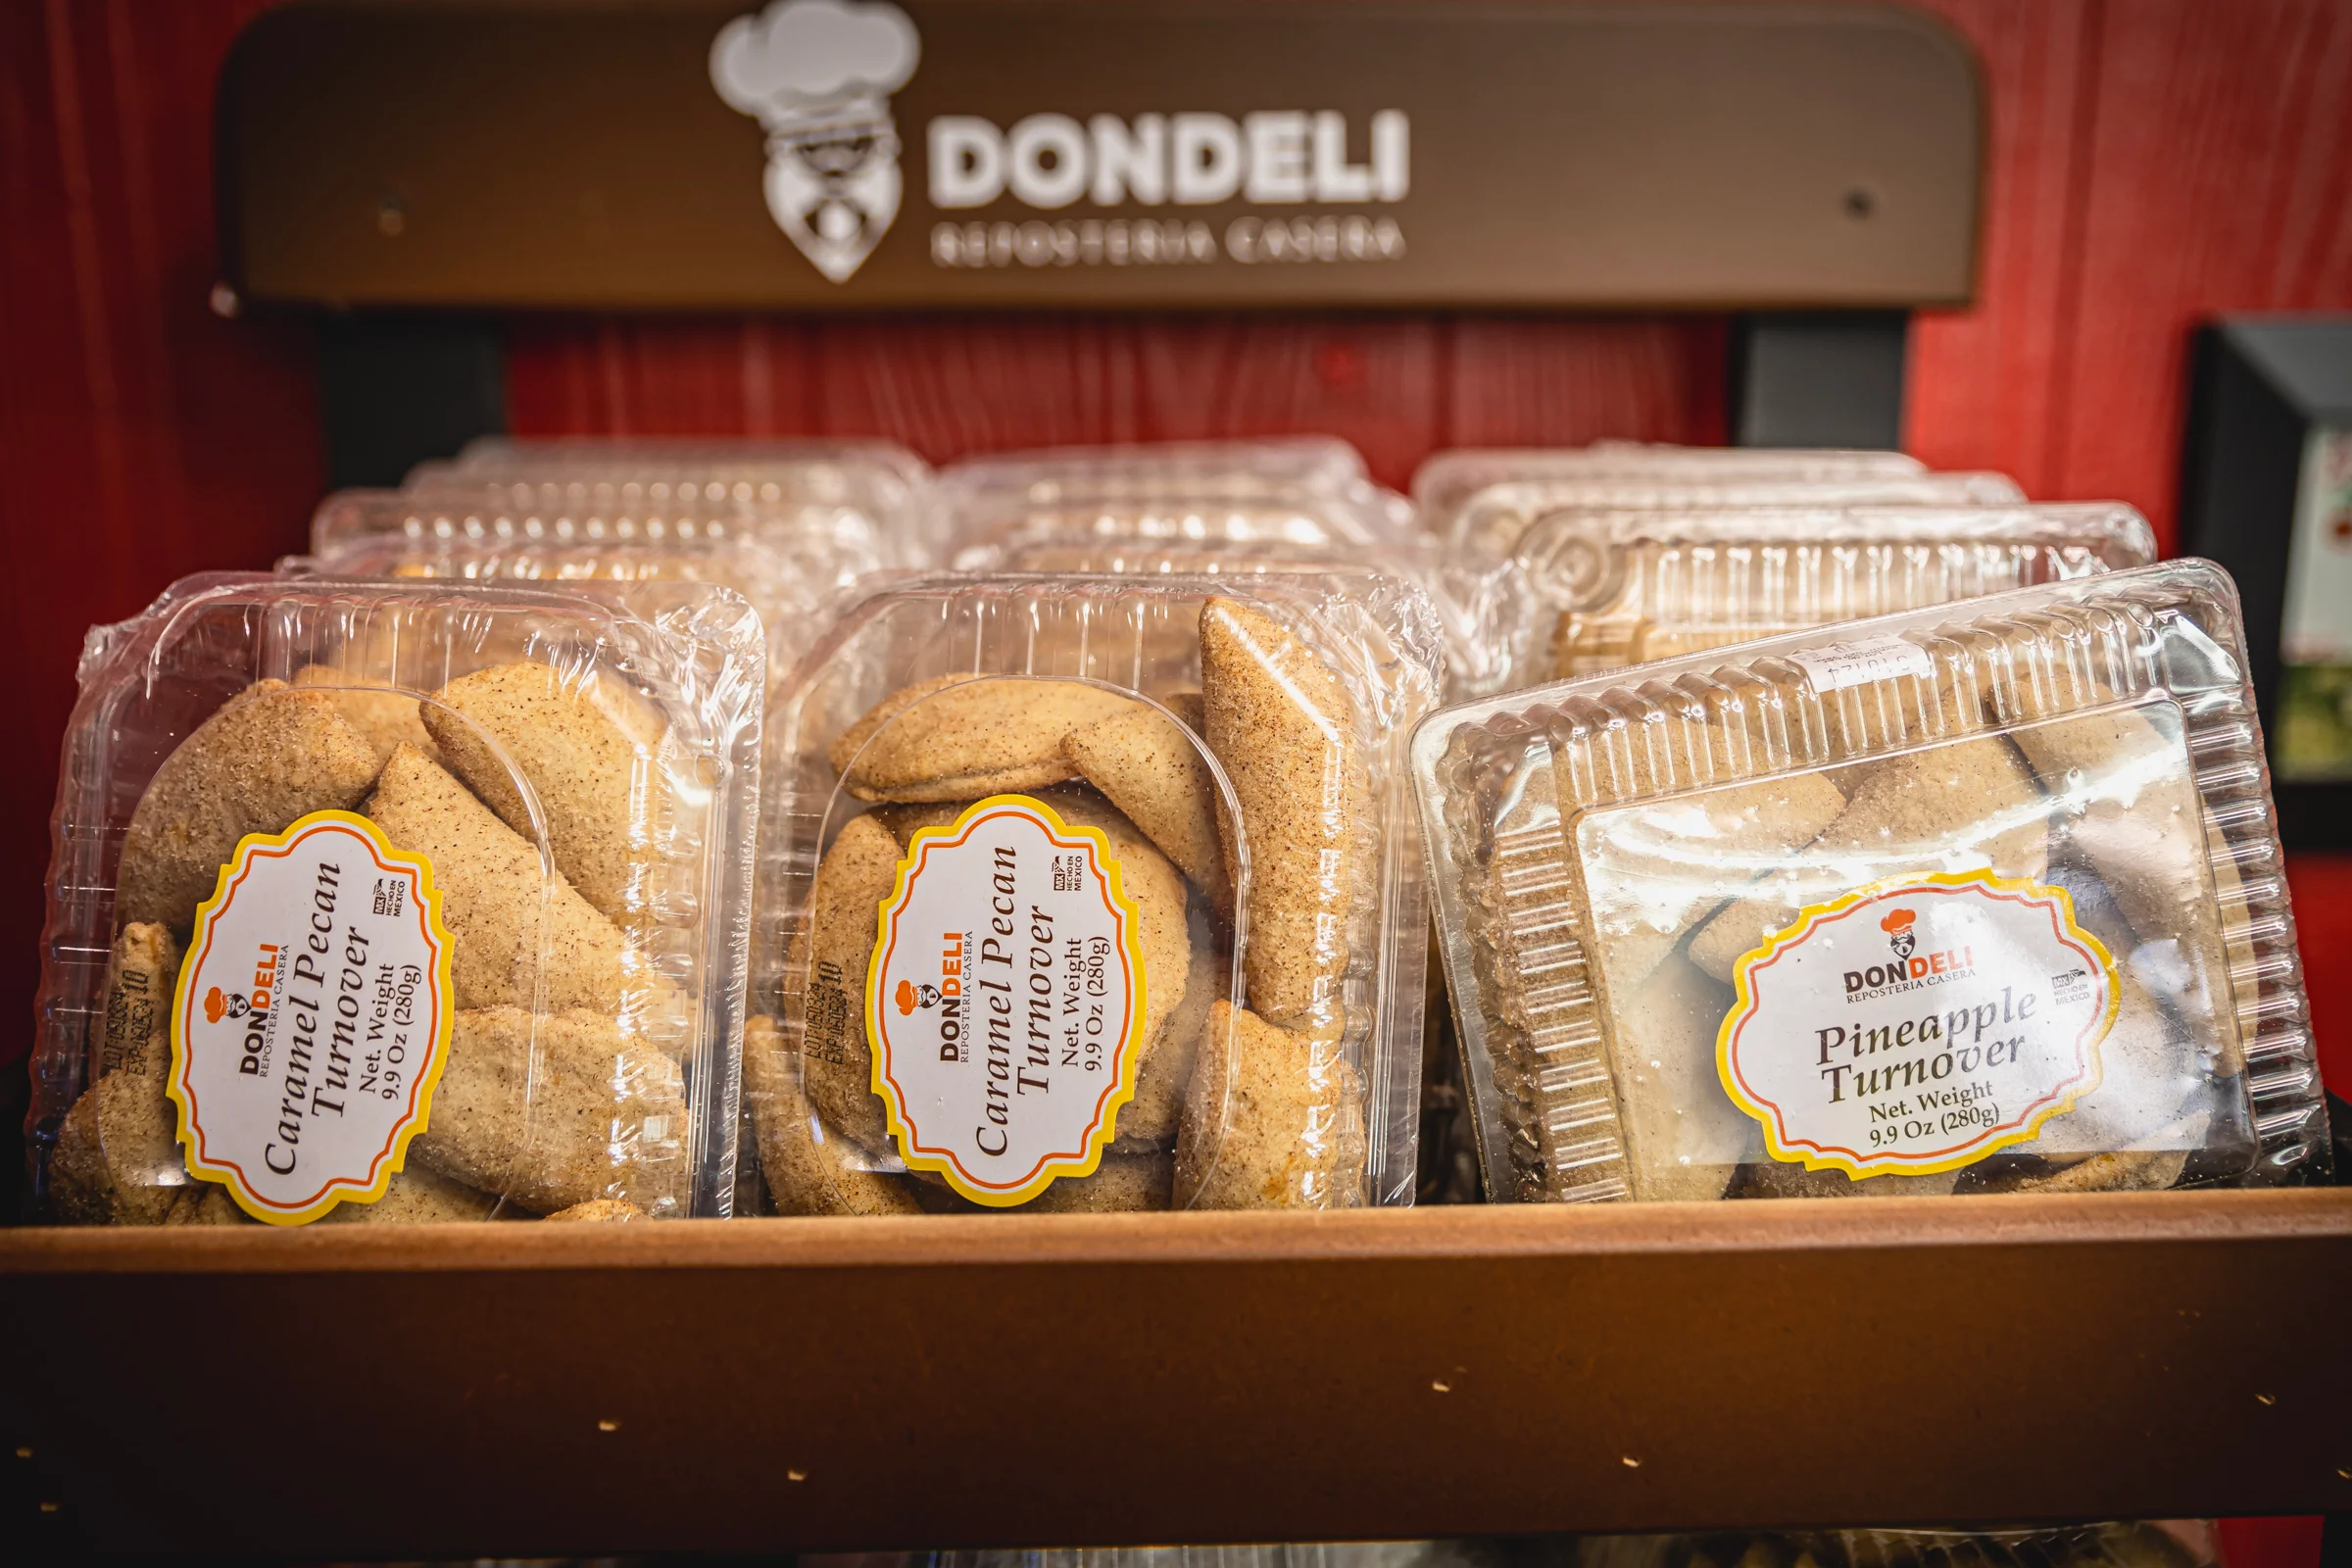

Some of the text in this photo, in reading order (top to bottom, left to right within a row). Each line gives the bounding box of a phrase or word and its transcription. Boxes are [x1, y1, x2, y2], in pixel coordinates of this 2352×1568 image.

[926, 109, 1410, 208] DONDELI
[1224, 216, 1407, 265] CASERA
[386, 880, 397, 915] HECHO EN
[393, 881, 406, 917] MEXICO
[1067, 856, 1073, 865] EN
[1074, 856, 1083, 891] MEXICO
[239, 944, 279, 1075] DONDELI
[259, 945, 290, 1078] REPOSTERIA CASERA
[265, 862, 341, 1176] Caramel Pecan
[940, 933, 963, 1061] DONDELI
[960, 930, 973, 1063] REPOSTERIA CASERA
[975, 846, 1017, 1156] Caramel Pecan
[1016, 906, 1054, 1095] Turnover
[1061, 938, 1087, 1067] Net. Weight
[1085, 936, 1110, 1071] 9.9 Oz (280g)
[1843, 946, 1974, 994] DONDELI
[1846, 968, 1976, 1004] REPOSTERIA CASERA
[2056, 992, 2089, 1005] MEXICO
[313, 926, 370, 1119] Turnover
[360, 963, 396, 1095] Net. Weight
[381, 964, 422, 1101] 9.9 Oz (280g)
[1815, 986, 2036, 1065] Pineapple
[1822, 1034, 2026, 1104] Turnover
[1869, 1081, 1993, 1123] Net. Weight
[1870, 1103, 2000, 1148] 9.9 Oz (280g)
